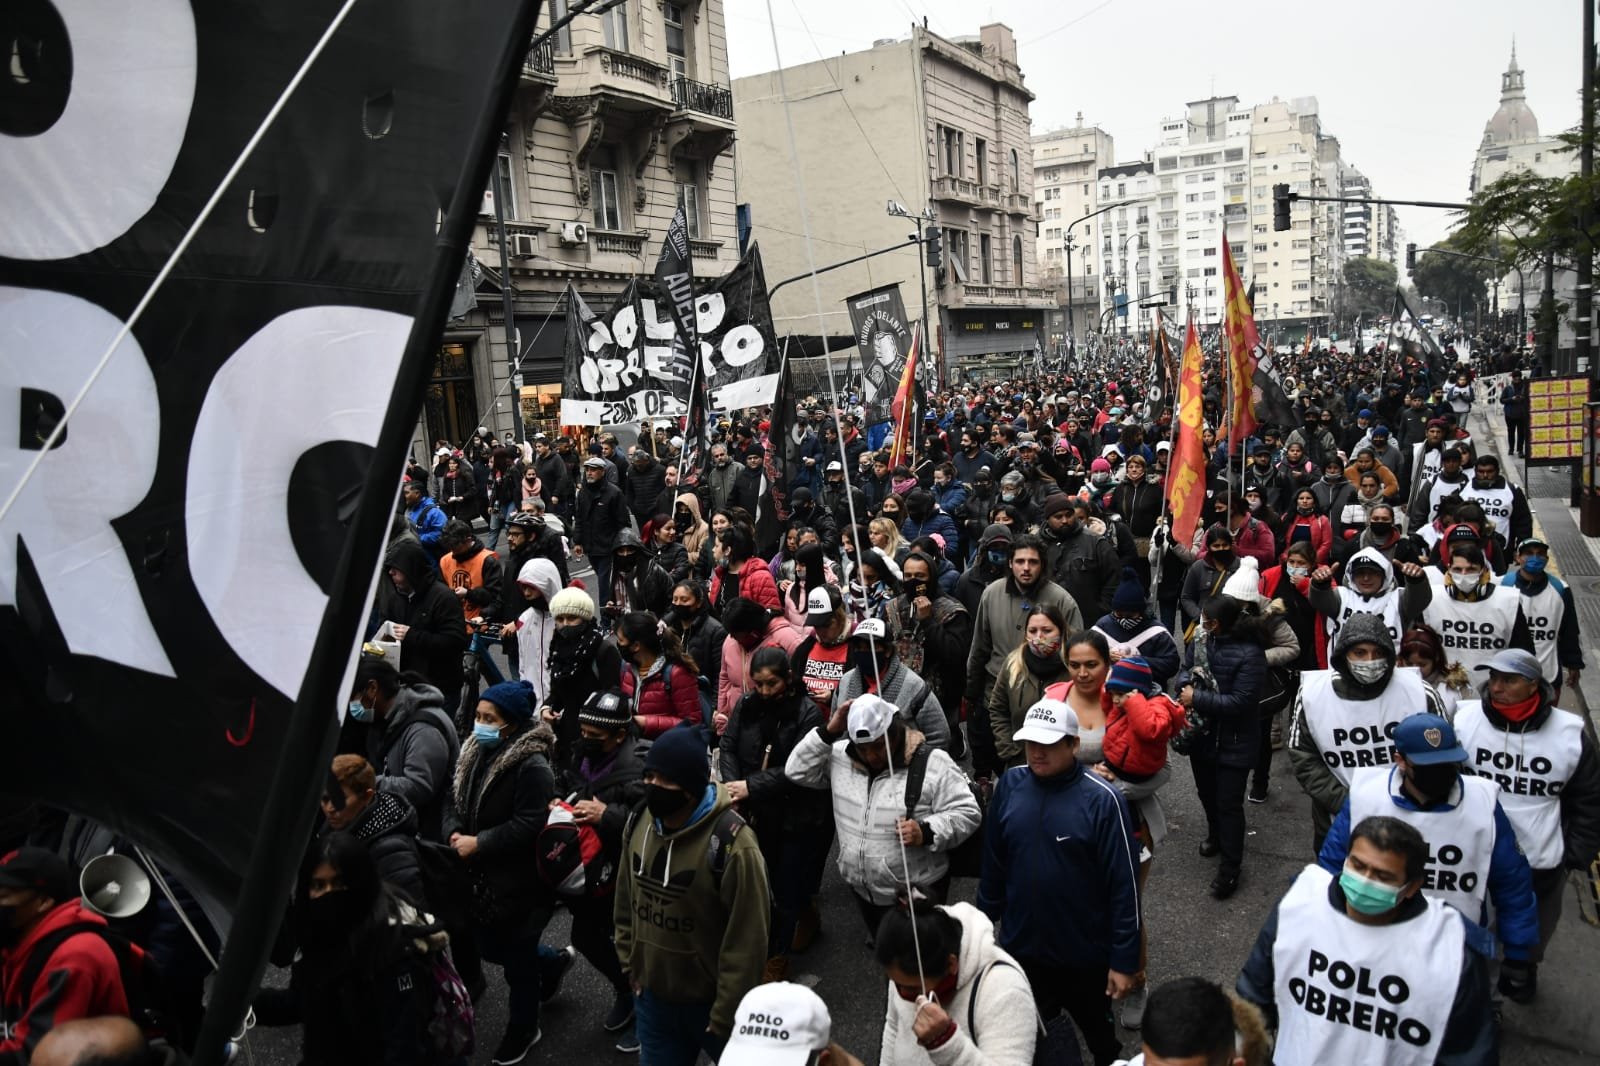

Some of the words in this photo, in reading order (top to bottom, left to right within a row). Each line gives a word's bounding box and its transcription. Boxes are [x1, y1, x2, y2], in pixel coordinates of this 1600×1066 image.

[861, 315, 874, 346] UNIDOS
[600, 397, 638, 425] ZONA
[644, 386, 728, 415] OESE
[1442, 619, 1495, 635] POLO
[1528, 616, 1549, 628] LO
[806, 660, 835, 670] FRENTE
[1323, 745, 1397, 768] OBRE
[1475, 747, 1553, 775] POLO
[1424, 843, 1463, 866] LO
[1422, 869, 1478, 893] ERO
[632, 900, 695, 933] adidas
[1308, 948, 1411, 1005] POLO
[748, 1012, 784, 1026] POLO
[1288, 977, 1431, 1047] OBRERO
[739, 1025, 790, 1041] OBRERO
